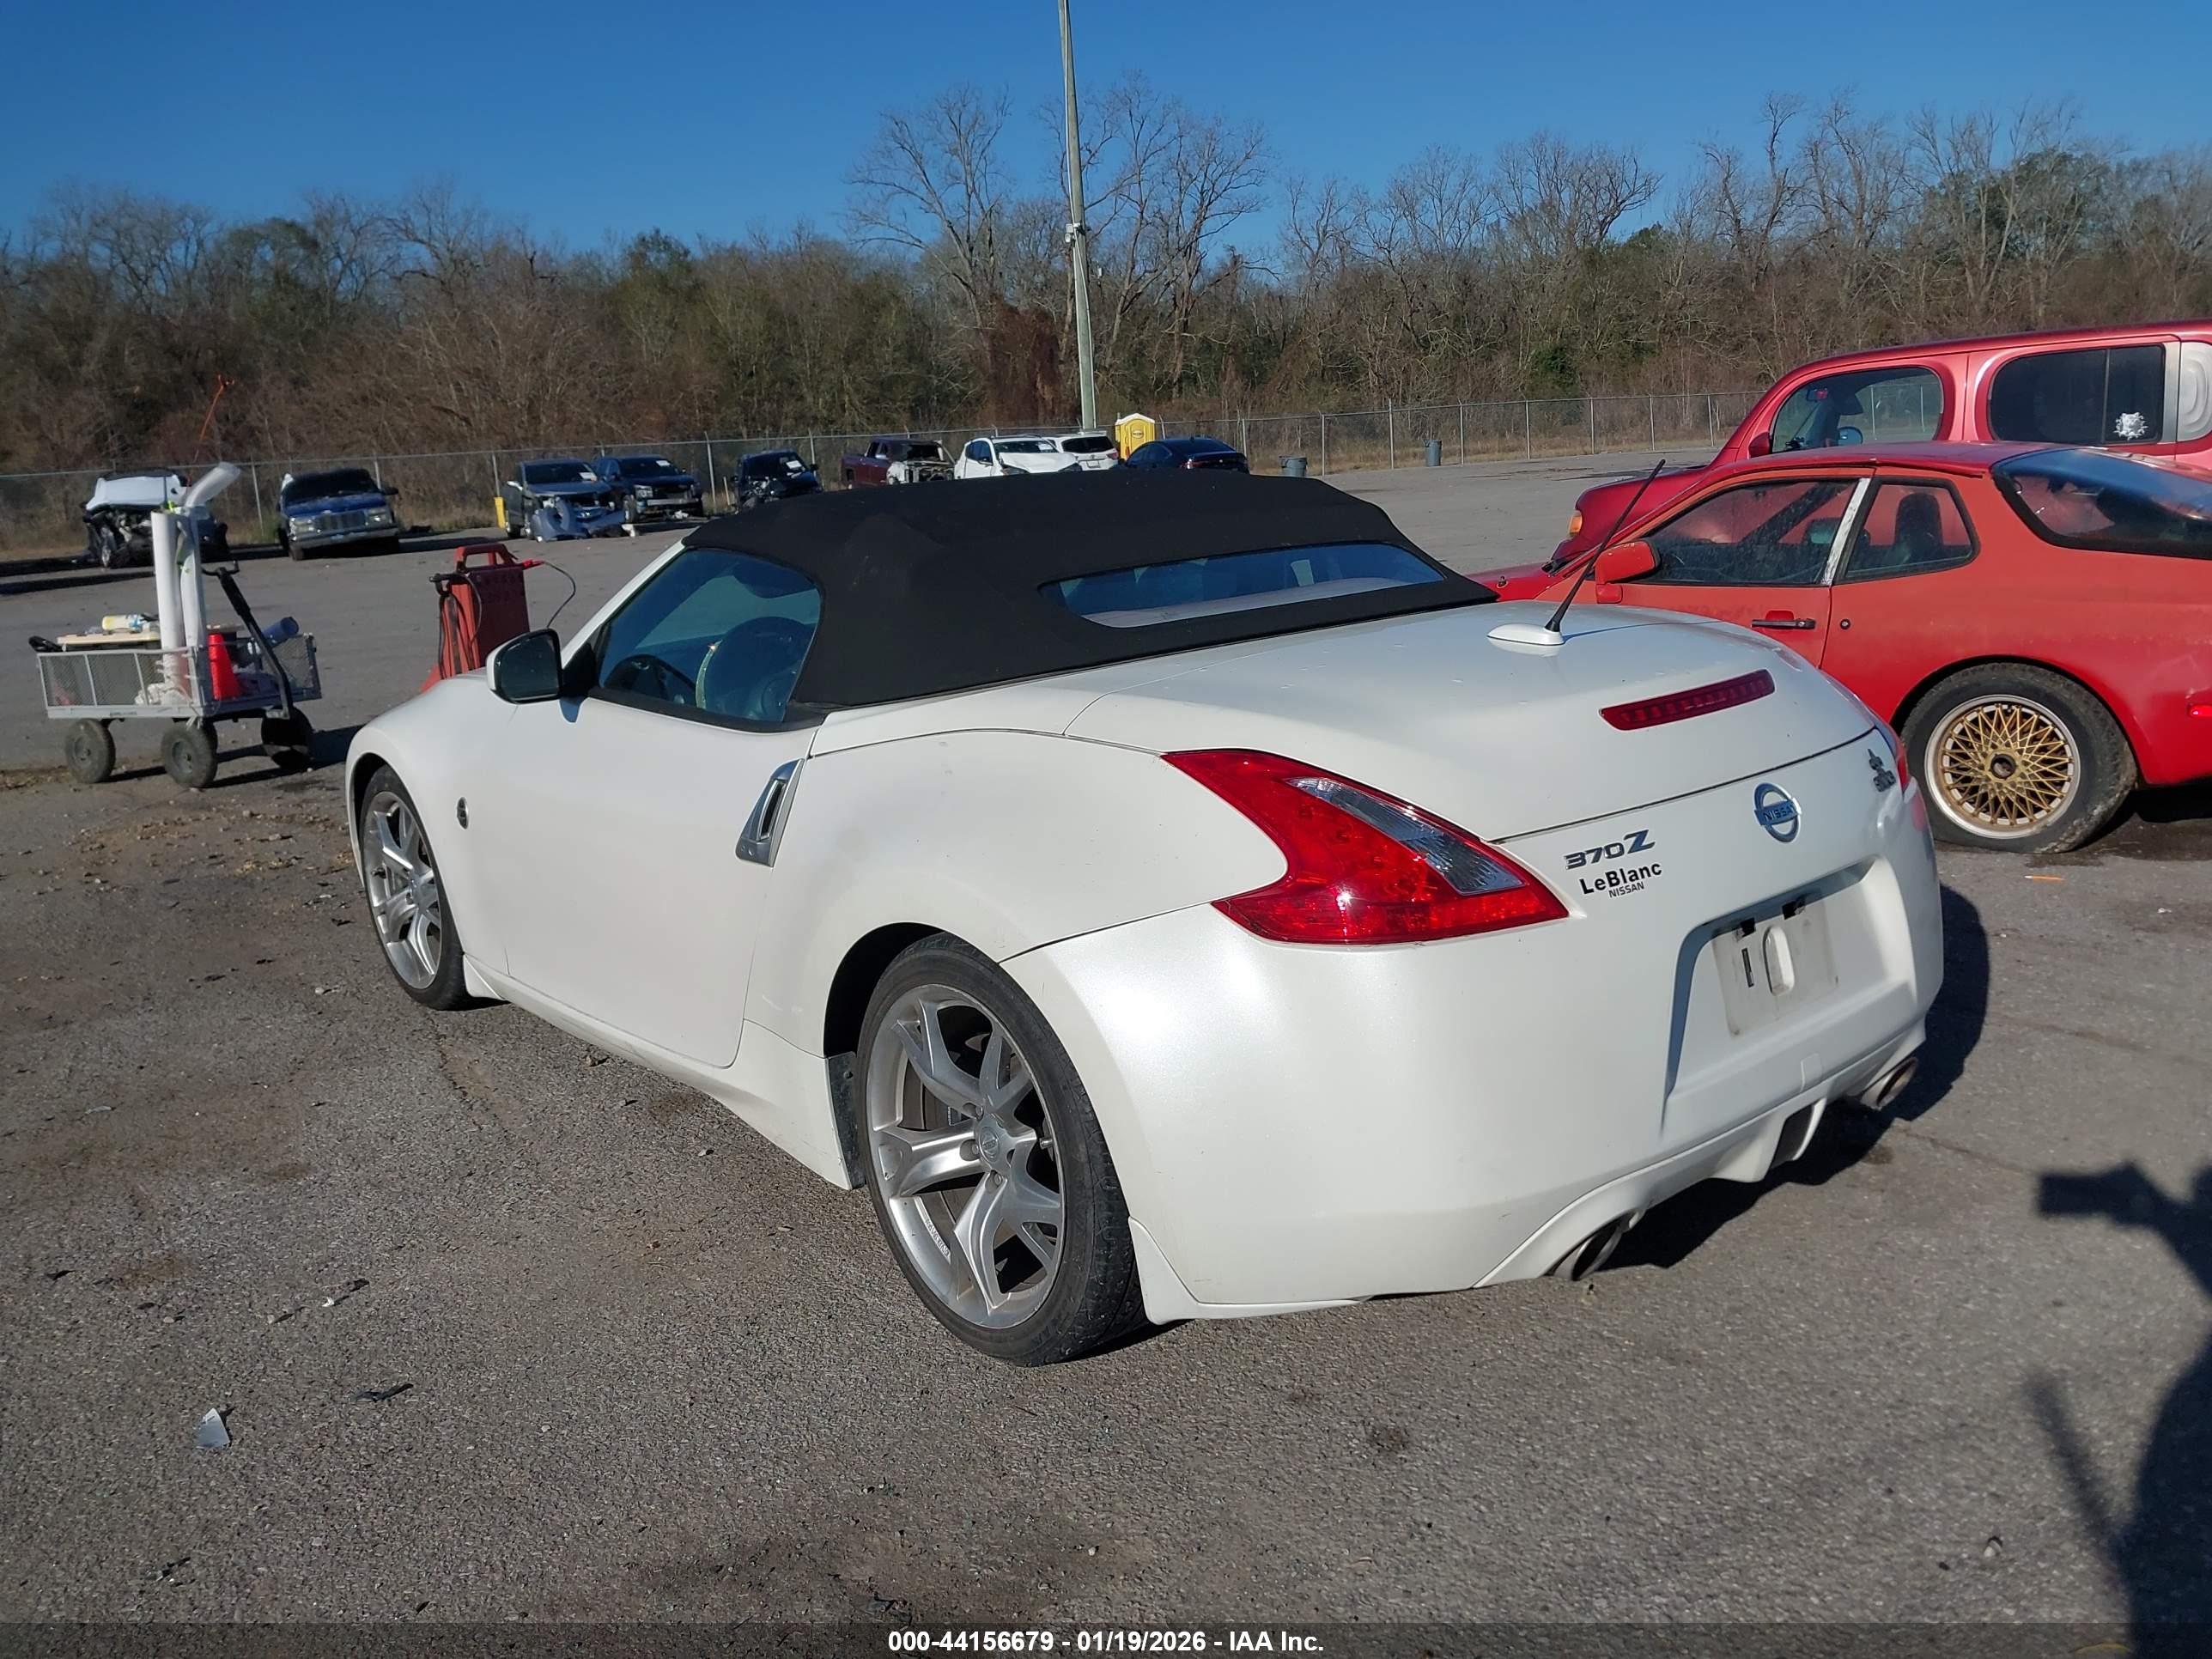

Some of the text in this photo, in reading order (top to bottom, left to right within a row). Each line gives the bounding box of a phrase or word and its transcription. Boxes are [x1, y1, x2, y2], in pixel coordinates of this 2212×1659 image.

[1564, 830, 1656, 870] 370Z
[1579, 864, 1662, 894] LeBlanc
[1608, 882, 1644, 898] NISSAN
